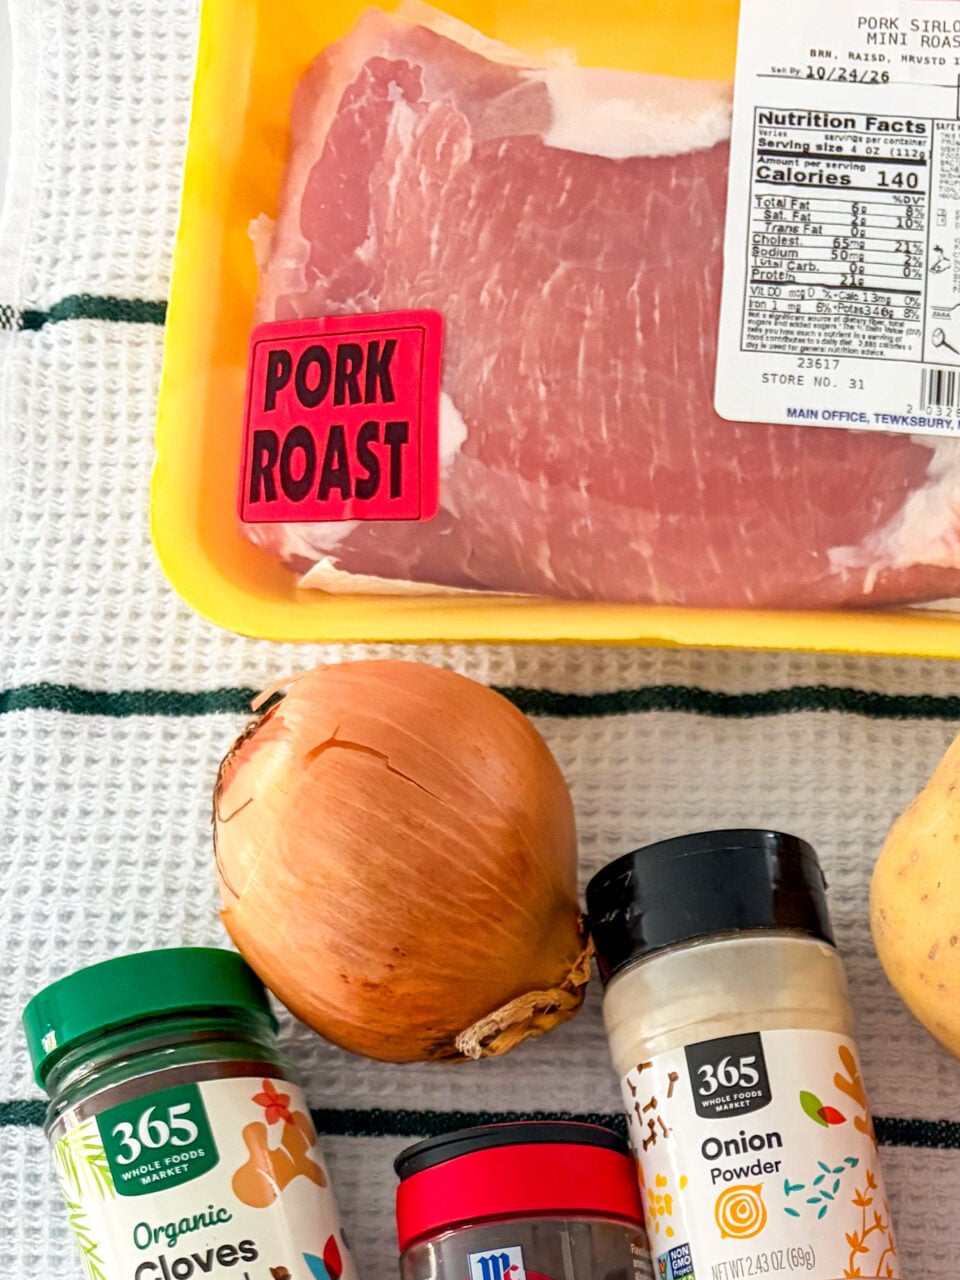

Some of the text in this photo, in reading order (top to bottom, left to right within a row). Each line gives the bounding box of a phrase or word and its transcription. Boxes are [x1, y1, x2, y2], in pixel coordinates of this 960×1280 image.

[858, 17, 900, 30] PORK
[866, 33, 907, 45] MINI
[901, 55, 946, 66] HRVSTD
[806, 66, 889, 83] 10/24/26
[758, 112, 927, 133] Nutrition Facts
[756, 166, 918, 187] Calories 140
[752, 246, 799, 258] Sodium
[752, 269, 795, 282] Protein
[798, 358, 840, 370] 23617
[264, 339, 398, 412] PORK
[762, 373, 865, 390] STORE NO. 31
[787, 408, 820, 421] MAIN
[822, 409, 870, 424] OFFICE,
[873, 413, 952, 430] TEWKSBURY,
[249, 420, 409, 504] ROAST
[697, 1056, 759, 1096] 365
[702, 1090, 762, 1108] WHOLE FOODS
[716, 1100, 750, 1112] MARKET
[112, 1103, 199, 1166] 365
[701, 1130, 783, 1161] Onion
[122, 1148, 205, 1181] WHOLE FOODS
[140, 1164, 190, 1185] MARKET
[710, 1160, 782, 1184] Powder
[133, 1205, 232, 1250] Organic
[670, 1246, 689, 1260] NON
[672, 1257, 691, 1268] GMO
[730, 1260, 744, 1280] WT
[746, 1254, 769, 1276] 2.43
[771, 1250, 784, 1271] OZ
[786, 1245, 816, 1272] (69g)
